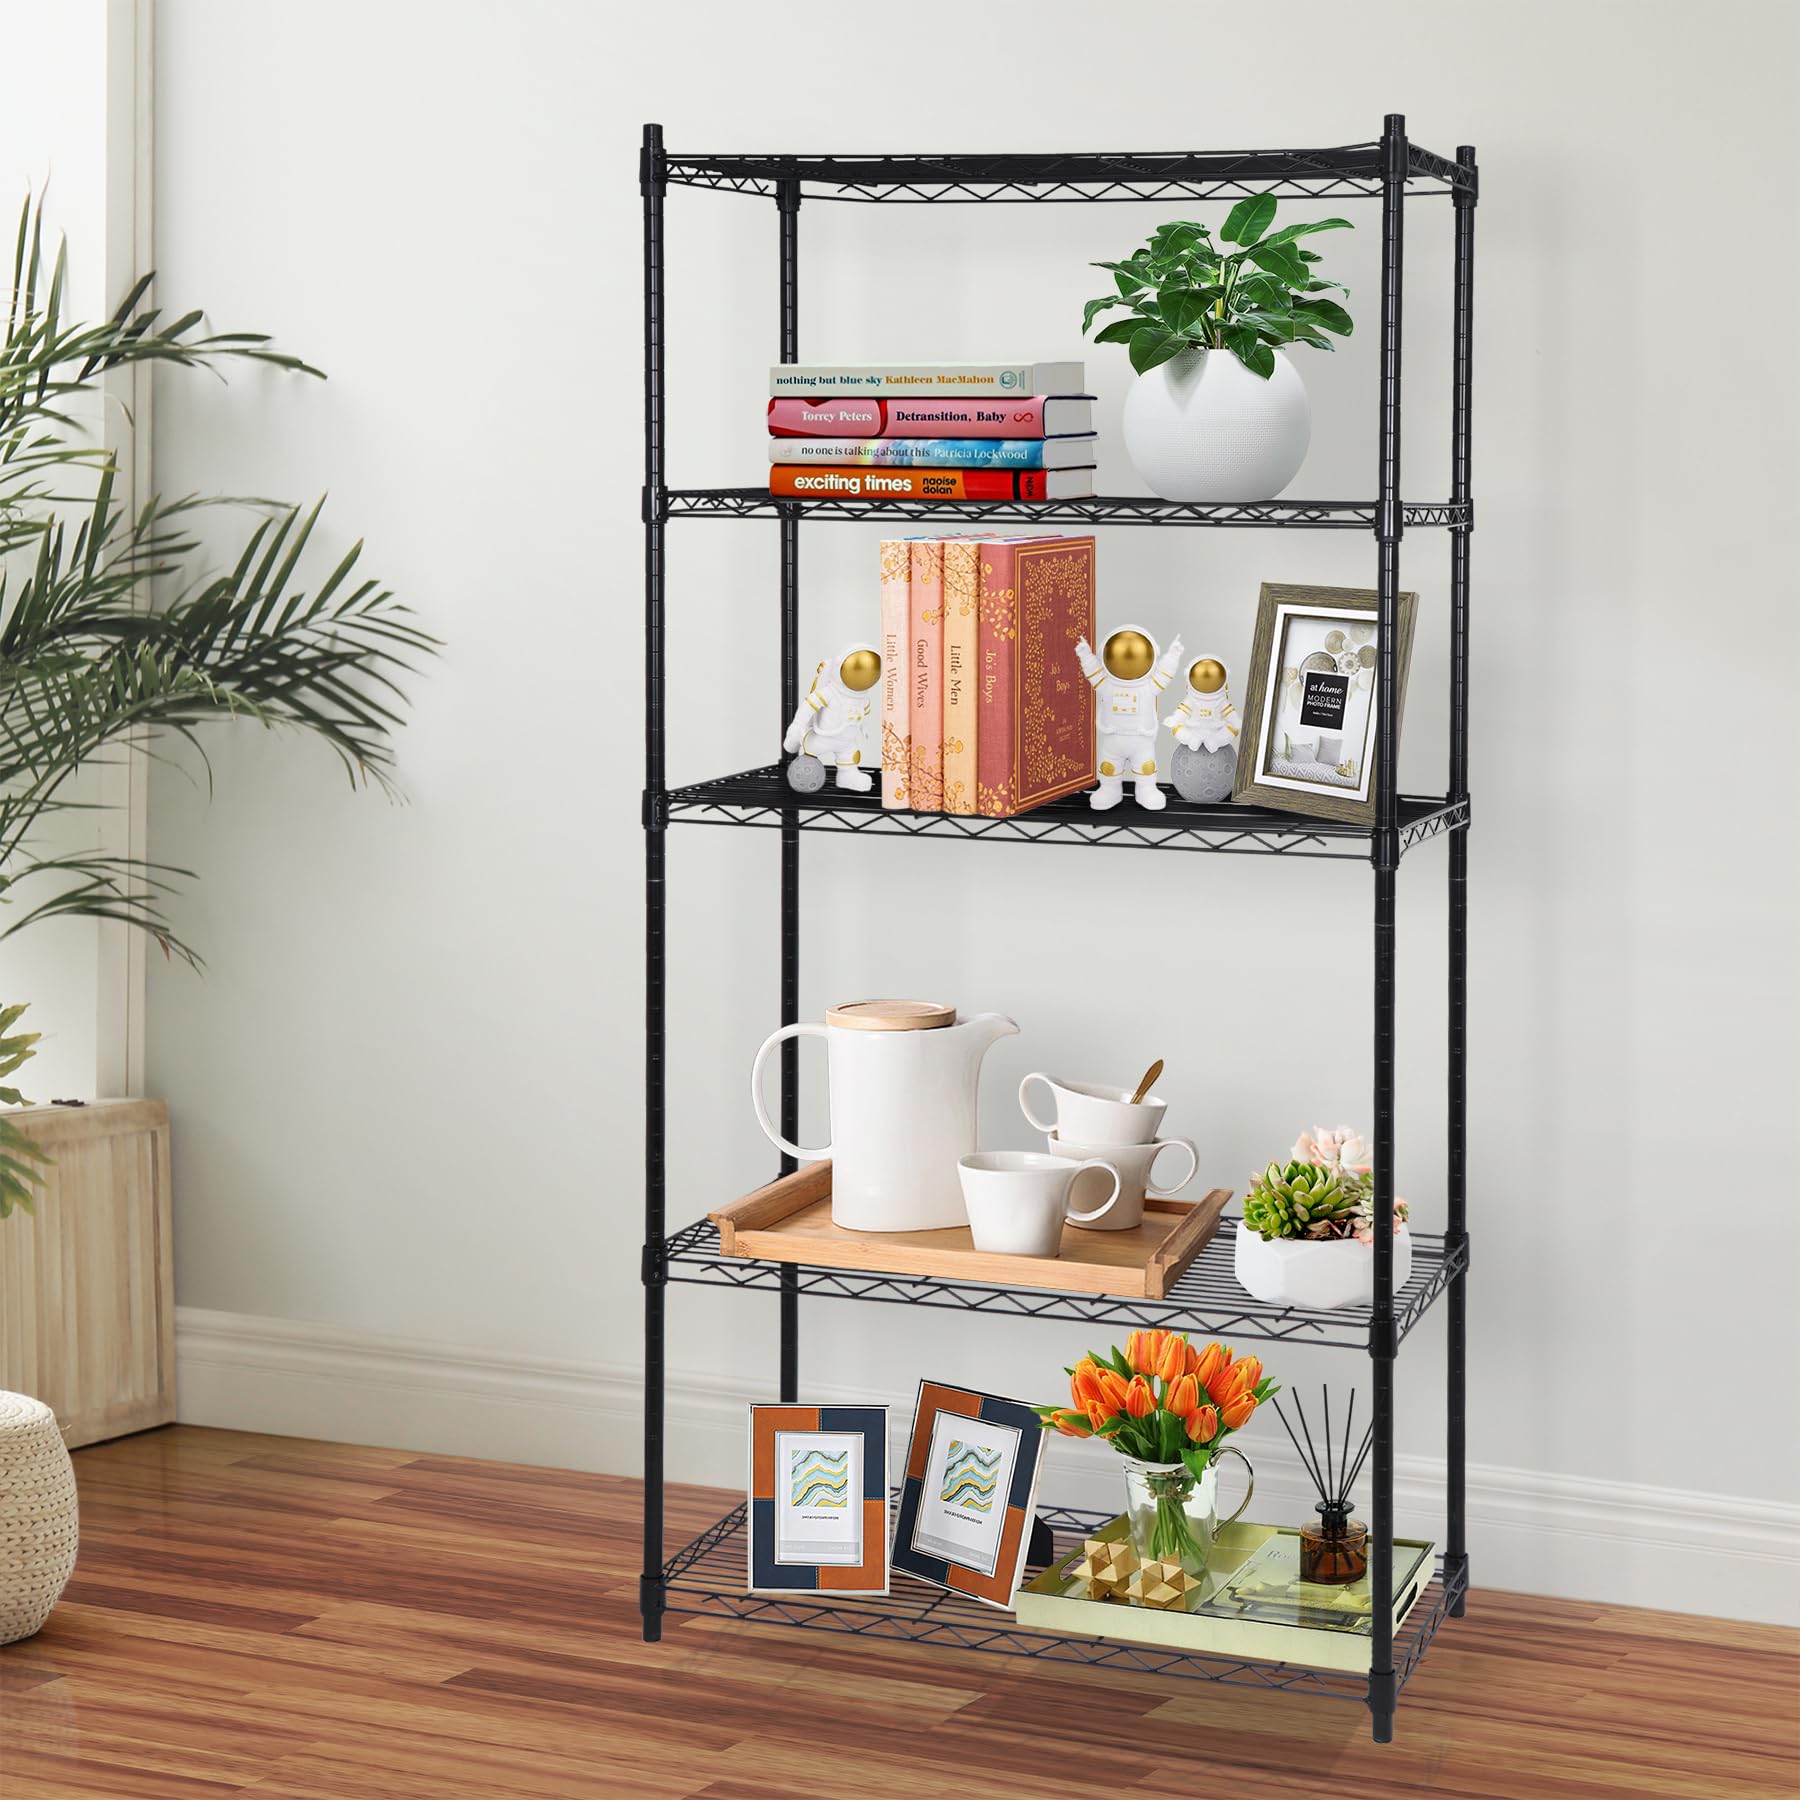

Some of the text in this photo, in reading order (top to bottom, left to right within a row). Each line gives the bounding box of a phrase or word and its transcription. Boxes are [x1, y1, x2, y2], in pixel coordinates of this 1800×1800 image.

[776, 375, 995, 386] nothing but blue sky Kathleen MacMahon
[801, 411, 1007, 423] Torrey Peters Detransition, Baby
[801, 446, 1028, 460] no one is talking about this Patricia Lockwood
[794, 474, 912, 494] exciting times
[922, 476, 957, 486] naoise
[922, 485, 953, 495] dolan
[886, 634, 898, 711] Little Women
[917, 639, 928, 708] Good Wives
[950, 645, 962, 705] Little Men
[982, 649, 997, 704] Jo's Boys
[1319, 681, 1343, 694] home
[1307, 694, 1342, 704] MODERN
